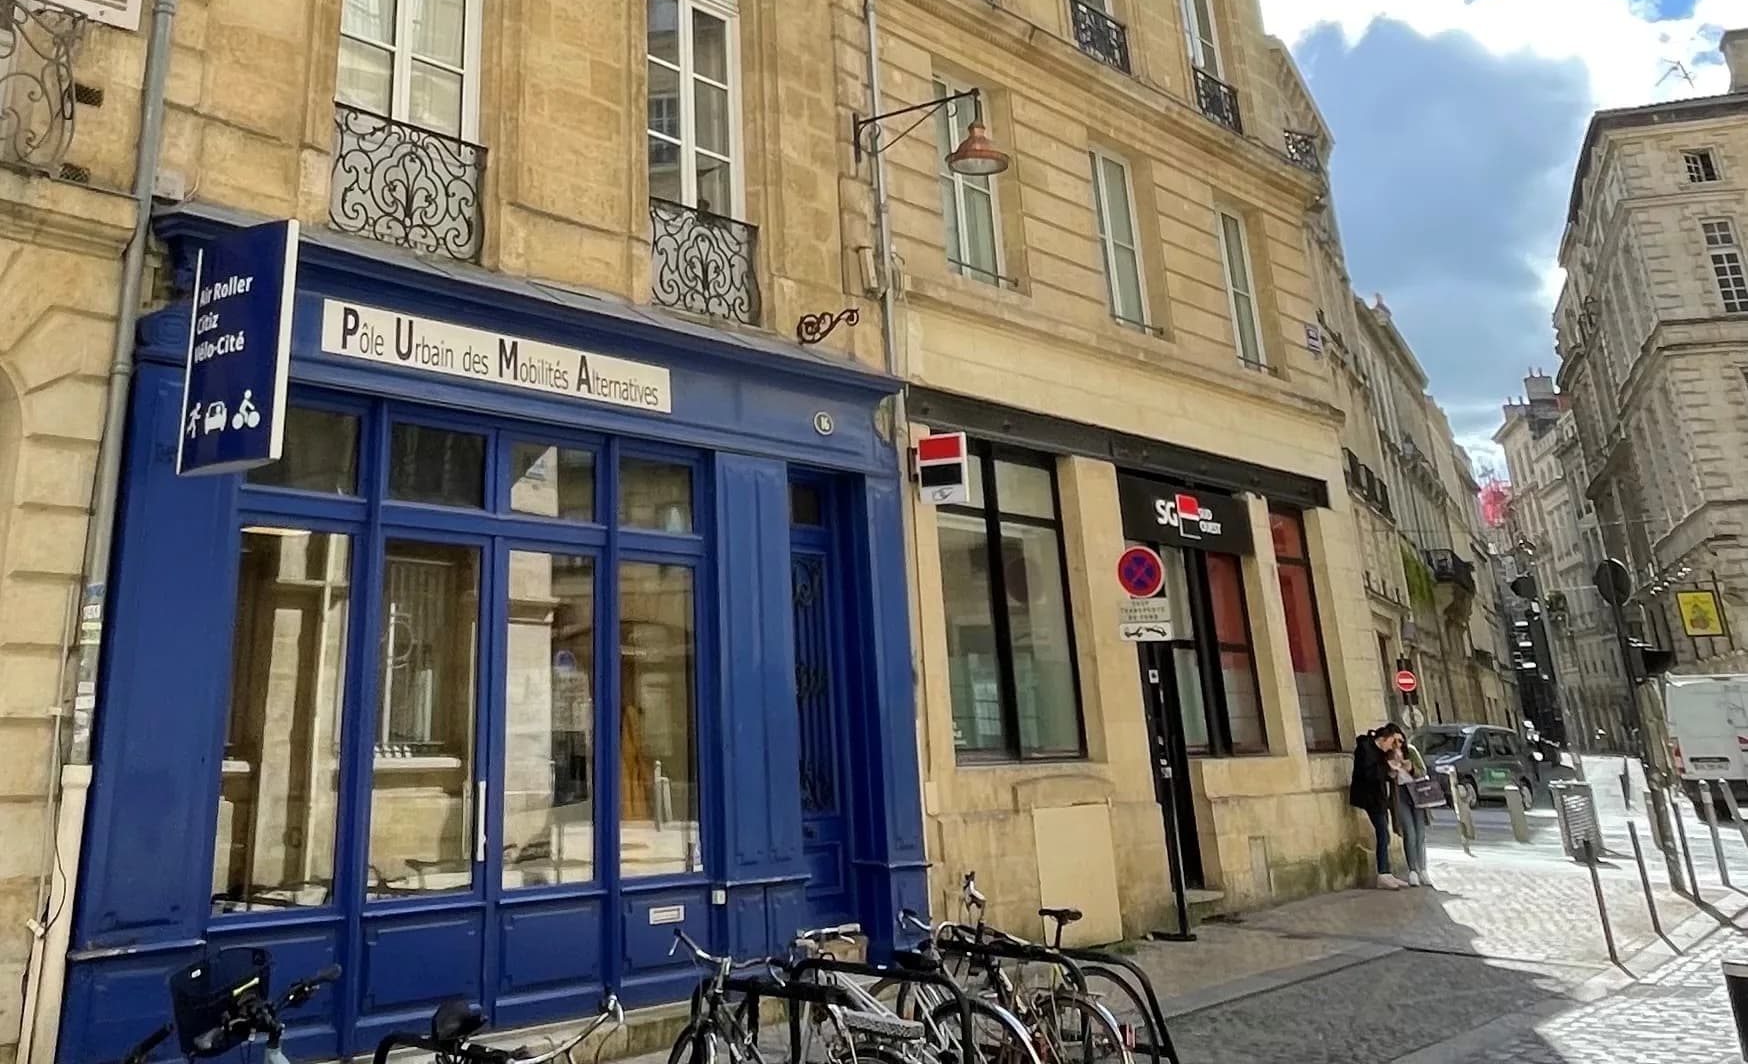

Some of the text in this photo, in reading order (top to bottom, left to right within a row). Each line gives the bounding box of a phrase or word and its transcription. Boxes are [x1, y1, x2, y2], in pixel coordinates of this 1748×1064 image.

[213, 276, 253, 300] Roller
[197, 311, 219, 335] Citiz
[194, 330, 245, 364] Vélo-Cité
[341, 306, 658, 406] Pôle Urbain des Mobilités Alternatives
[1155, 499, 1180, 527] SG
